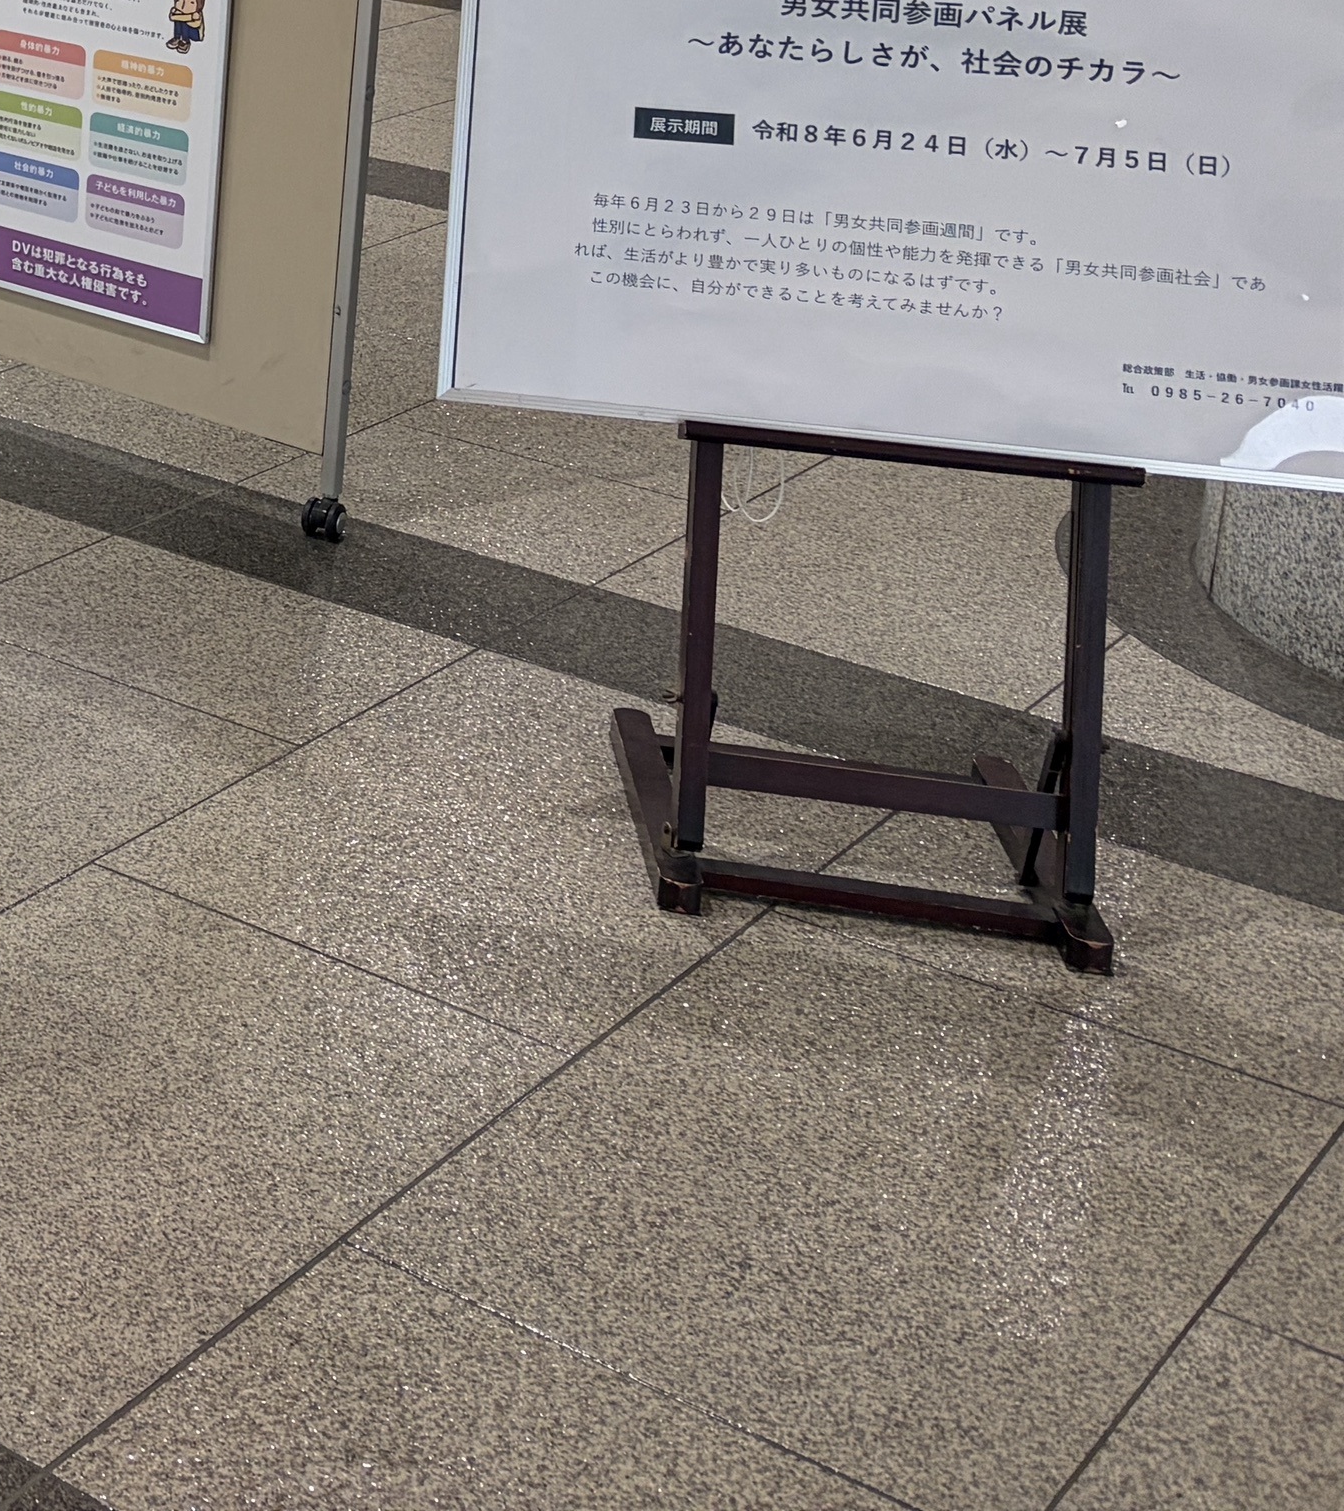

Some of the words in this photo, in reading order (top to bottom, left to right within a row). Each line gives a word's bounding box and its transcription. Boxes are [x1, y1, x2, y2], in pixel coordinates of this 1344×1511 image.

[20, 39, 60, 56] 身体的暴力
[688, 29, 1181, 87] 〜あなたらしさが、社会のチカラ〜
[121, 59, 164, 77] 精神的暴力
[20, 101, 52, 117] 性的暴力
[117, 123, 161, 140] 経済的暴力
[649, 116, 719, 139] 展示期間
[14, 161, 54, 179] 社会的暴力
[95, 181, 176, 208] 子どもを利用した暴力
[12, 238, 148, 288] DVは犯罪となる行為をも
[592, 216, 1267, 293] 性別にとらわれず、一人ひとりの個性や能力を発揮できる「男女共同参画社会」であ
[574, 242, 998, 296] れば、生活がより豊かで実り多いものになるはずです。
[11, 257, 147, 307] 含む重大な人権侵害です。
[590, 270, 1003, 321] この機会に、自分ができることを考えてみませんか？
[1122, 363, 1175, 377] 総合政策部
